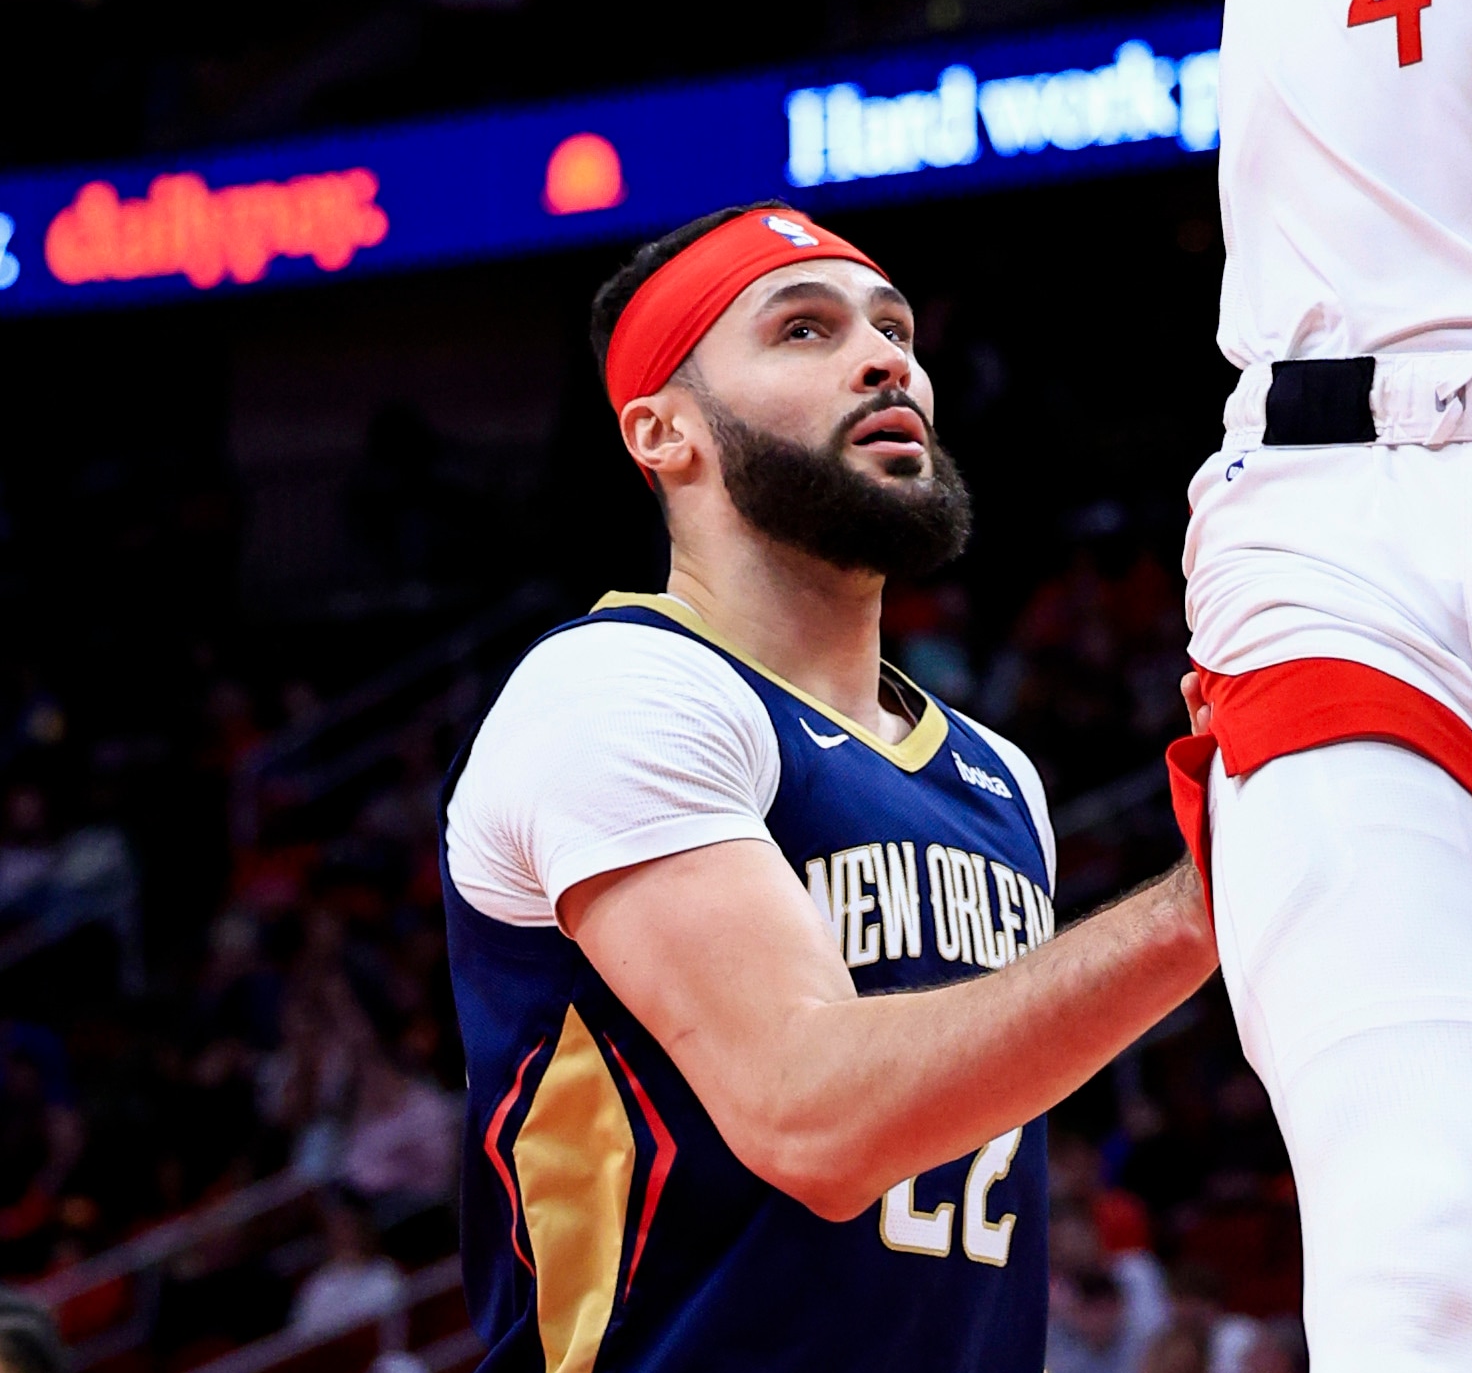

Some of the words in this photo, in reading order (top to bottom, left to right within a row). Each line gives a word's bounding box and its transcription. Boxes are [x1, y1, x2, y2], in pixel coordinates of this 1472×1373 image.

[786, 64, 979, 188] Hard
[977, 39, 1180, 153] work
[951, 749, 1013, 798] ibotta
[806, 841, 922, 969] NEW
